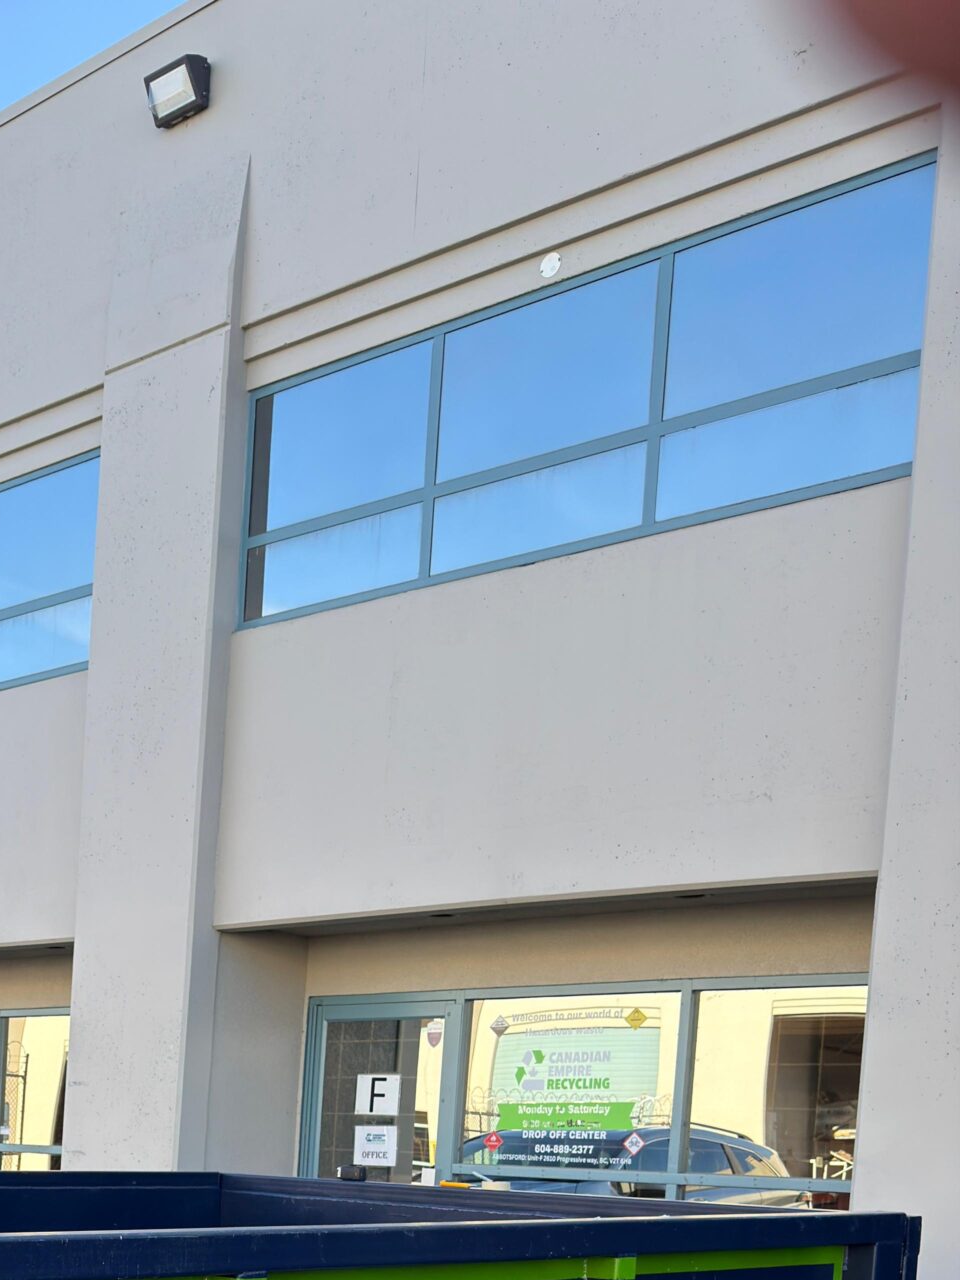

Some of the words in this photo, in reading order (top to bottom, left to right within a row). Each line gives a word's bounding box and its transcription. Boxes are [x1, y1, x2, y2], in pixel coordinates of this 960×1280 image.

[511, 1013, 551, 1022] Welcome
[556, 1012, 564, 1020] to
[585, 1010, 612, 1019] world
[614, 1008, 624, 1018] of
[548, 1051, 611, 1064] CANADIAN
[548, 1065, 592, 1077] EMPIRE
[546, 1078, 610, 1090] RECYCLING
[369, 1077, 387, 1112] F
[518, 1105, 553, 1116] Monday
[556, 1104, 566, 1114] to
[568, 1103, 611, 1116] Saturday
[522, 1130, 547, 1139] DROP
[549, 1130, 567, 1139] OFF
[569, 1130, 607, 1140] CENTER
[361, 1151, 388, 1159] OFFICE
[534, 1144, 594, 1155] 604-889-2377
